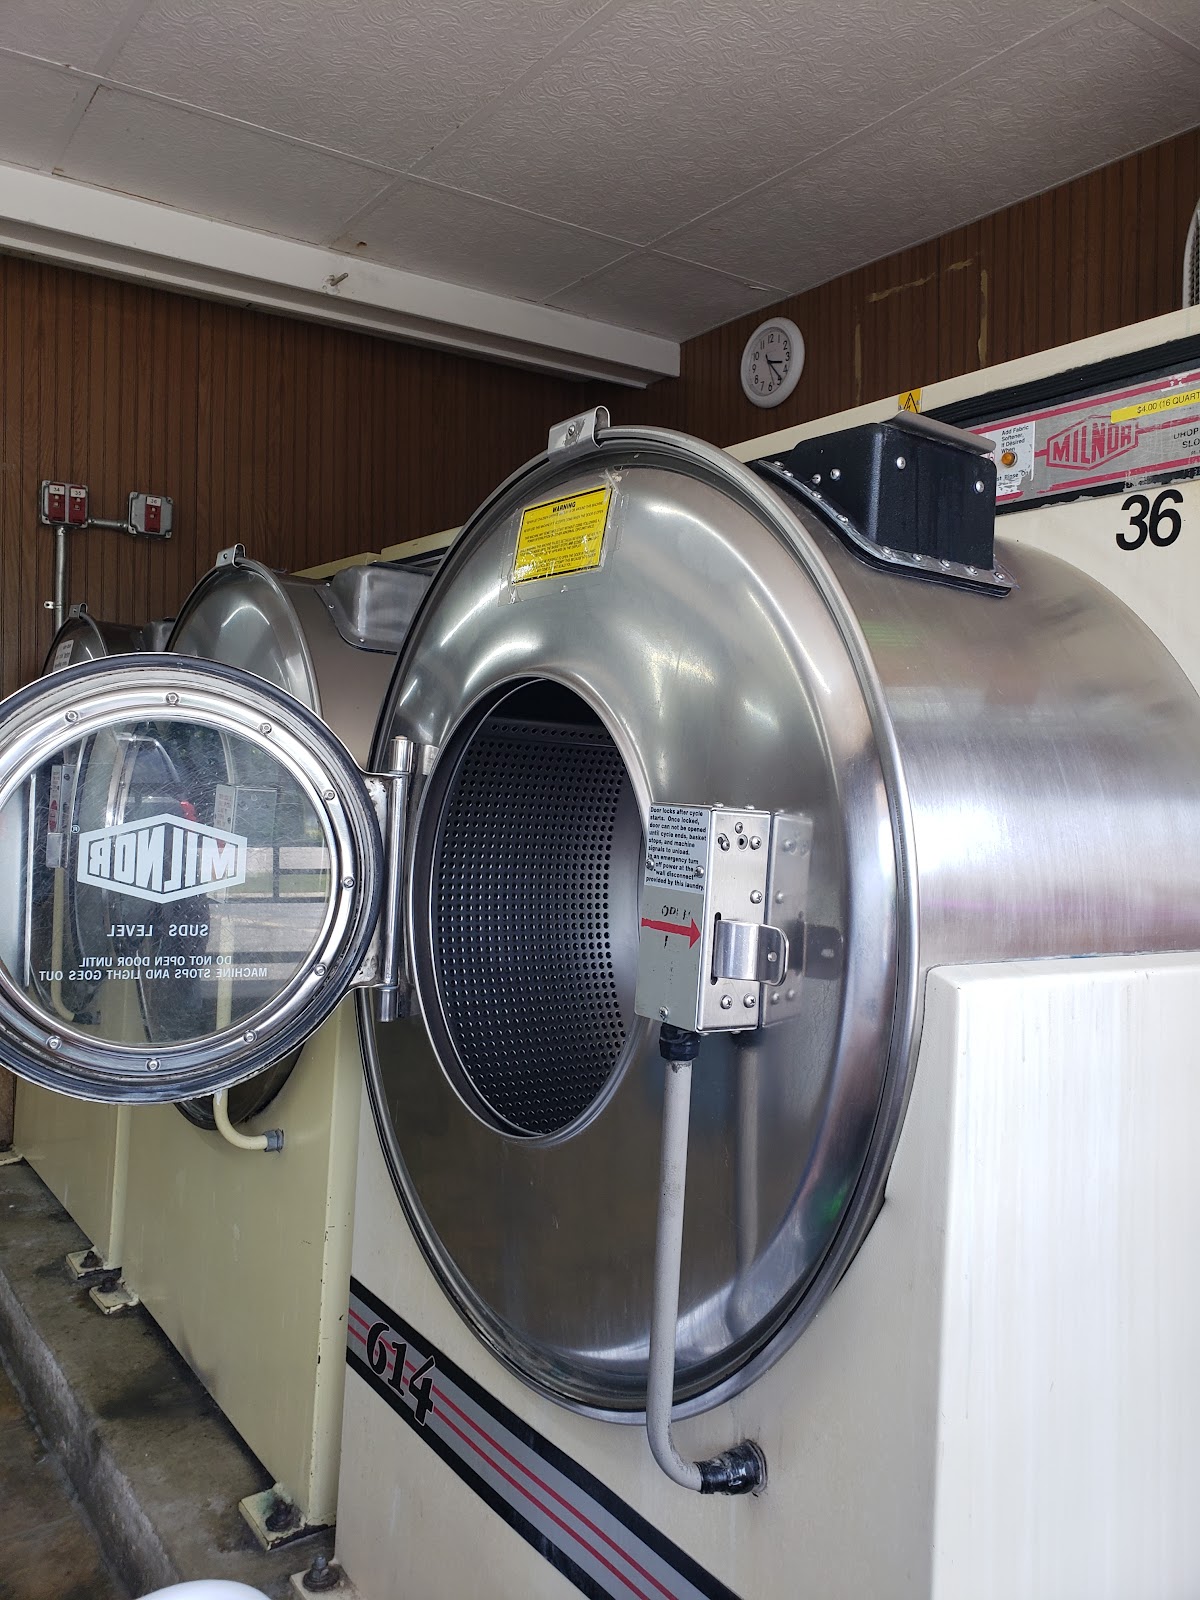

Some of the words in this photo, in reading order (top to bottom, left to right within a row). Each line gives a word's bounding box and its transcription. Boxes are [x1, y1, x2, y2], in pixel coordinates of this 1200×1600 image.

[768, 334, 775, 344] 12
[760, 340, 765, 350] 11
[783, 340, 788, 350] 2
[753, 352, 759, 361] 10
[786, 352, 790, 361] 3
[752, 364, 756, 373] 9
[783, 364, 788, 372] 4
[755, 375, 759, 384] 8
[760, 381, 765, 391] 7
[768, 382, 773, 391] 6
[1137, 403, 1157, 414] $4.00
[1006, 438, 1025, 447] Desired
[1053, 421, 1132, 464] MILNOR
[552, 501, 576, 513] WARNING
[1116, 489, 1184, 550] 36
[674, 840, 695, 848] machine
[660, 855, 687, 864] emergency
[646, 876, 667, 884] provided
[667, 878, 674, 886] by
[366, 1320, 436, 1426] 614
